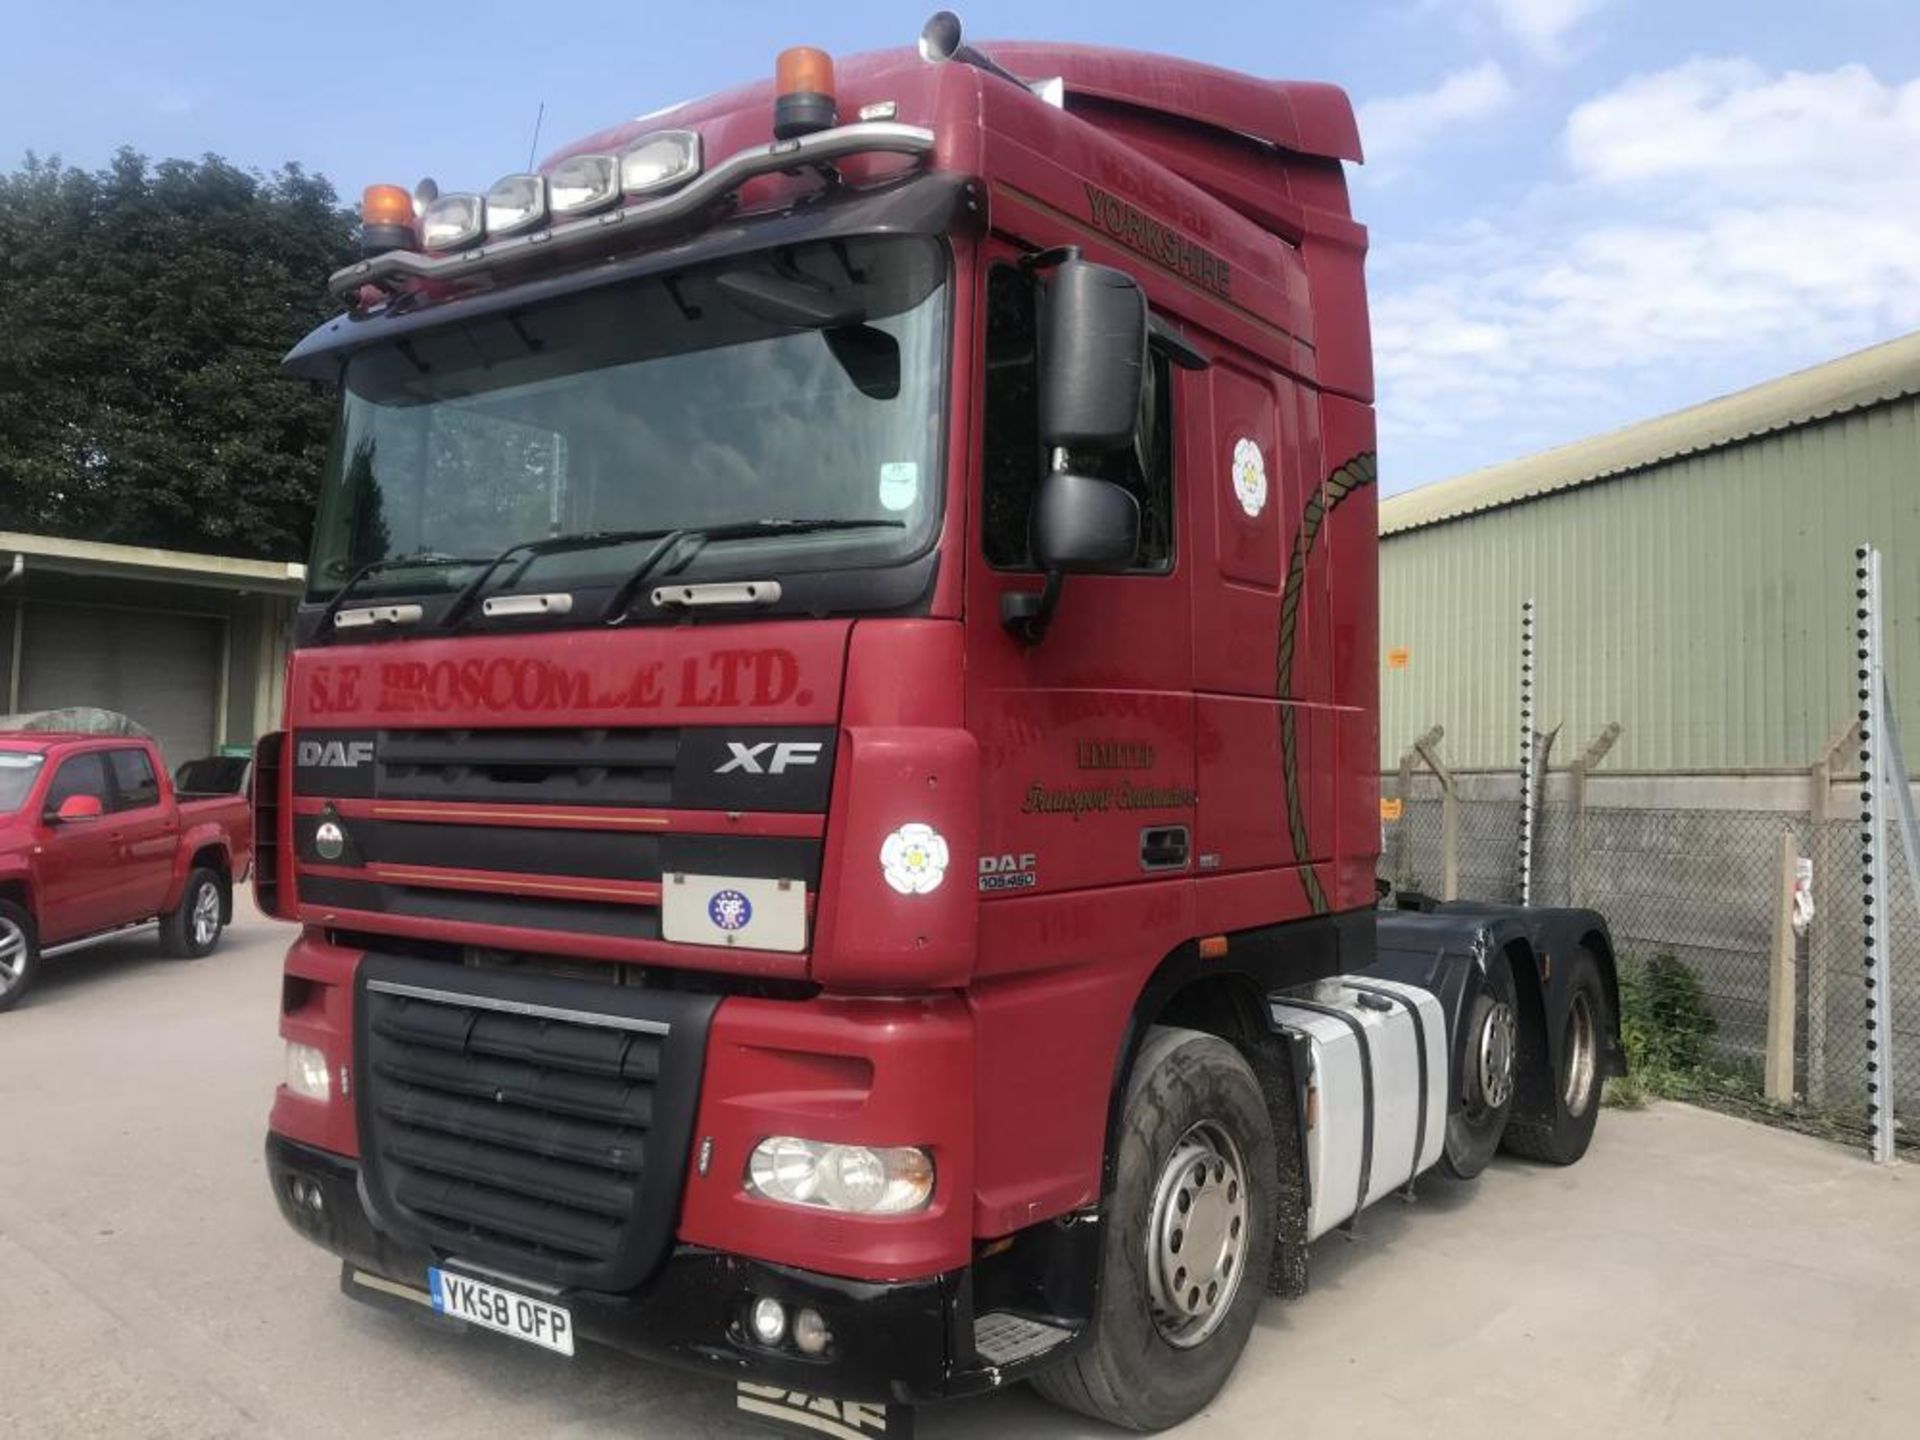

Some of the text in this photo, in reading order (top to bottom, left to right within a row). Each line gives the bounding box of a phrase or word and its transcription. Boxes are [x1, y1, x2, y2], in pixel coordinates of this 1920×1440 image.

[1084, 182, 1230, 299] YORKSHIRE
[676, 649, 814, 707] LTD.
[297, 741, 374, 768] DAF
[713, 742, 823, 774] XF
[979, 853, 1036, 874] DAF
[719, 899, 741, 915] GB
[445, 1277, 566, 1344] YK58 OFP
